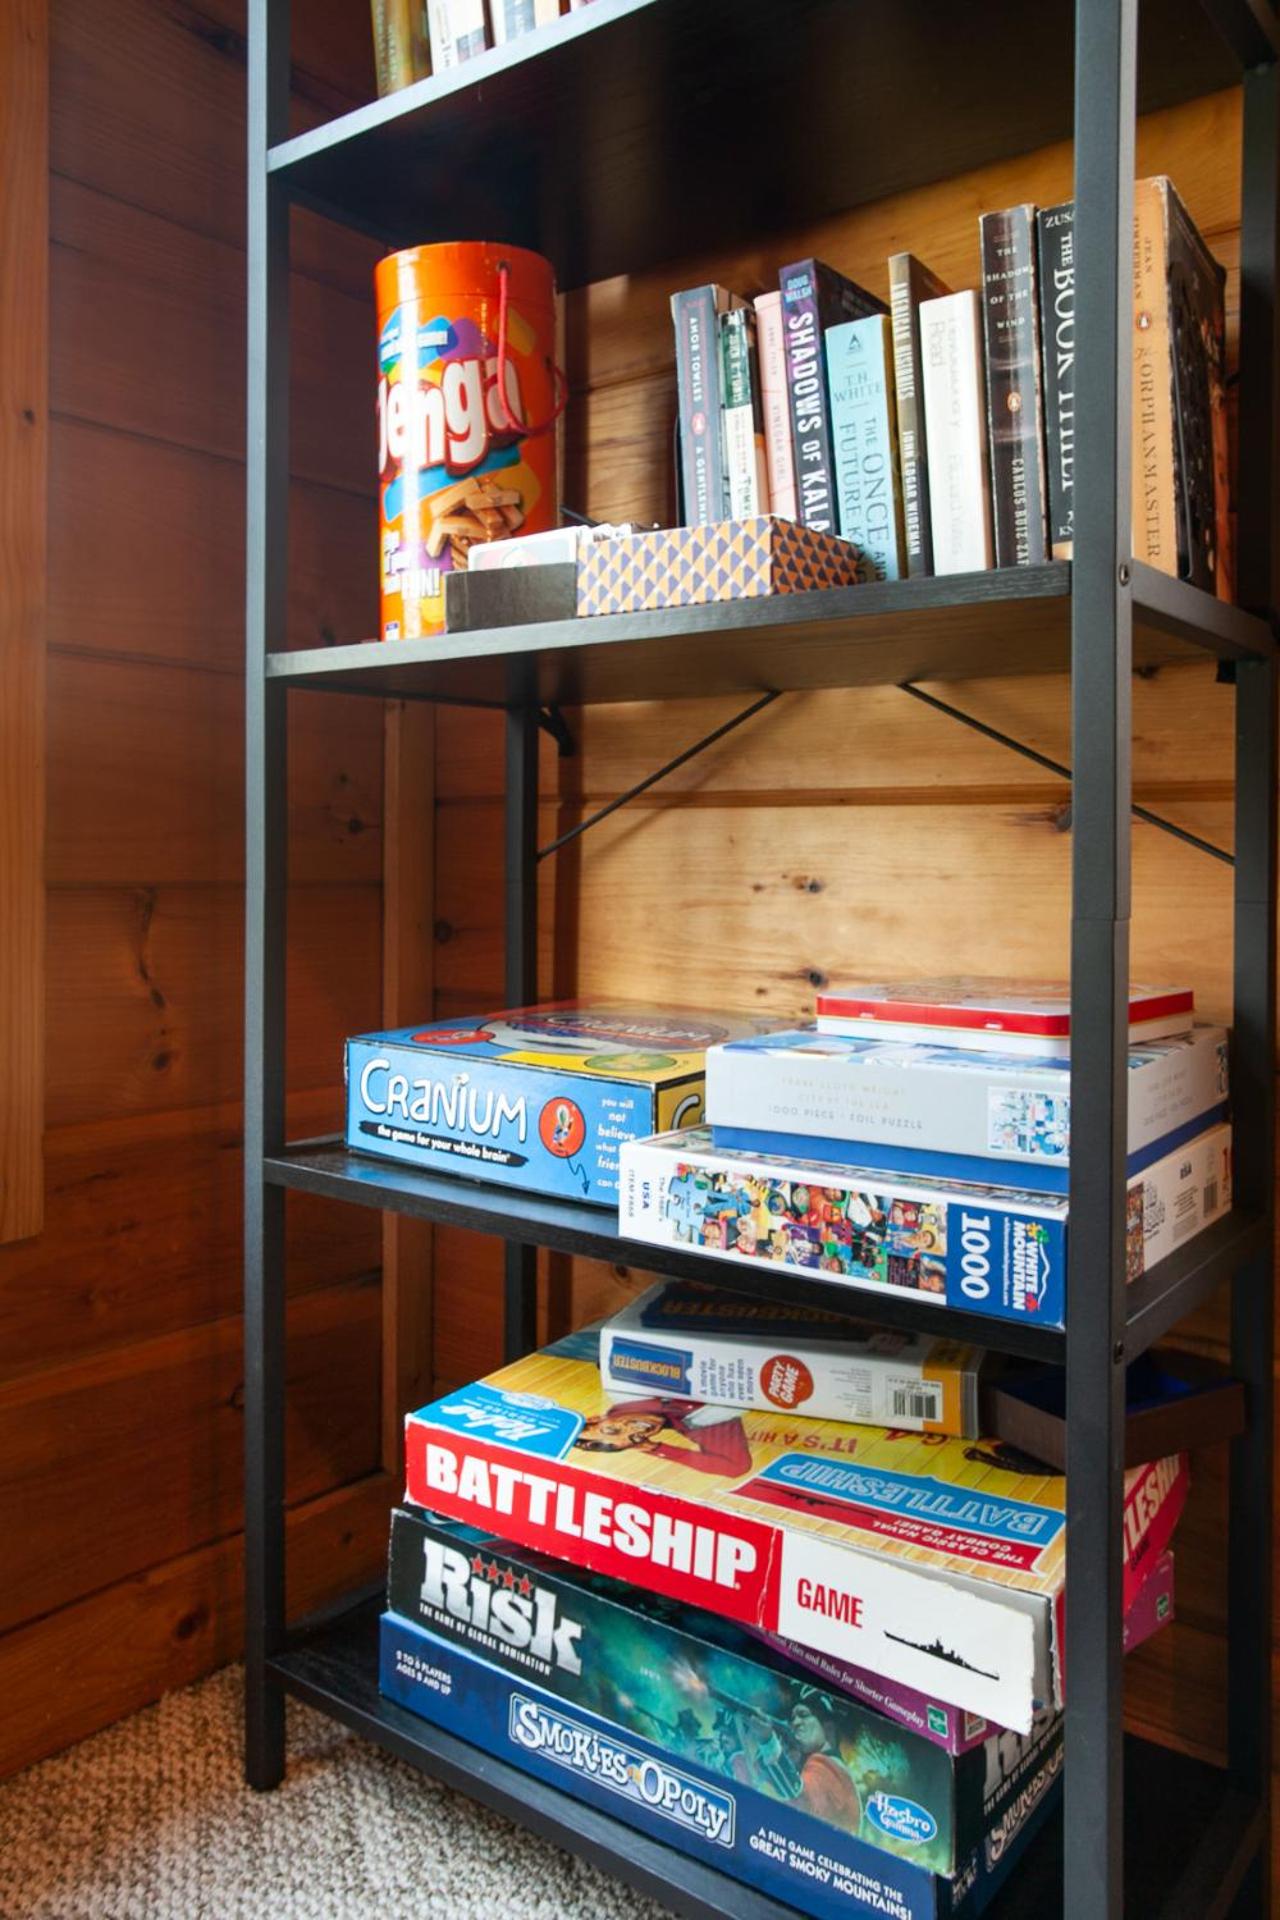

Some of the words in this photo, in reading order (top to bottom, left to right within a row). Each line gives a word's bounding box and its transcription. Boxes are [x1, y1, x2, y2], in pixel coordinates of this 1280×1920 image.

[1045, 212, 1075, 229] ZUS
[788, 312, 821, 435] SHADOWS
[802, 439, 822, 462] OF
[838, 423, 863, 516] FUTURE
[801, 469, 831, 535] KALA
[861, 452, 889, 545] ONCE
[1011, 457, 1026, 508] CARLOS
[1016, 541, 1031, 566] ZAF
[642, 1181, 651, 1209] USA
[960, 1211, 991, 1300] 1000
[1012, 1220, 1027, 1311] MOUNTAIN
[1026, 1240, 1039, 1294] WHITE
[612, 1353, 682, 1380] BLOCKBUSTER
[768, 1359, 786, 1398] PARTY
[779, 1363, 799, 1404] GAME
[783, 1434, 800, 1446] A
[801, 1436, 857, 1454] IT'S
[425, 1442, 758, 1590] BATTLESHIP
[780, 1461, 1050, 1536] BATTLESHIP
[420, 1537, 583, 1676] RISK
[796, 1578, 864, 1629] GAME
[419, 1602, 433, 1618] THE
[434, 1610, 455, 1629] GAME
[456, 1621, 466, 1635] OF
[467, 1626, 497, 1650] GLOBAL
[498, 1641, 551, 1677] DOMINATION
[421, 1661, 452, 1685] PLAYERS
[868, 1790, 931, 1833] Hasbro
[749, 1835, 788, 1866] GREAT
[788, 1853, 830, 1883] SMOKY
[832, 1876, 912, 1920] MOUNTAINS!
[757, 1827, 766, 1837] A
[768, 1831, 787, 1848] FUN
[788, 1839, 816, 1863] GAME
[817, 1852, 882, 1892] CELEBRATING
[882, 1884, 904, 1904] THE
